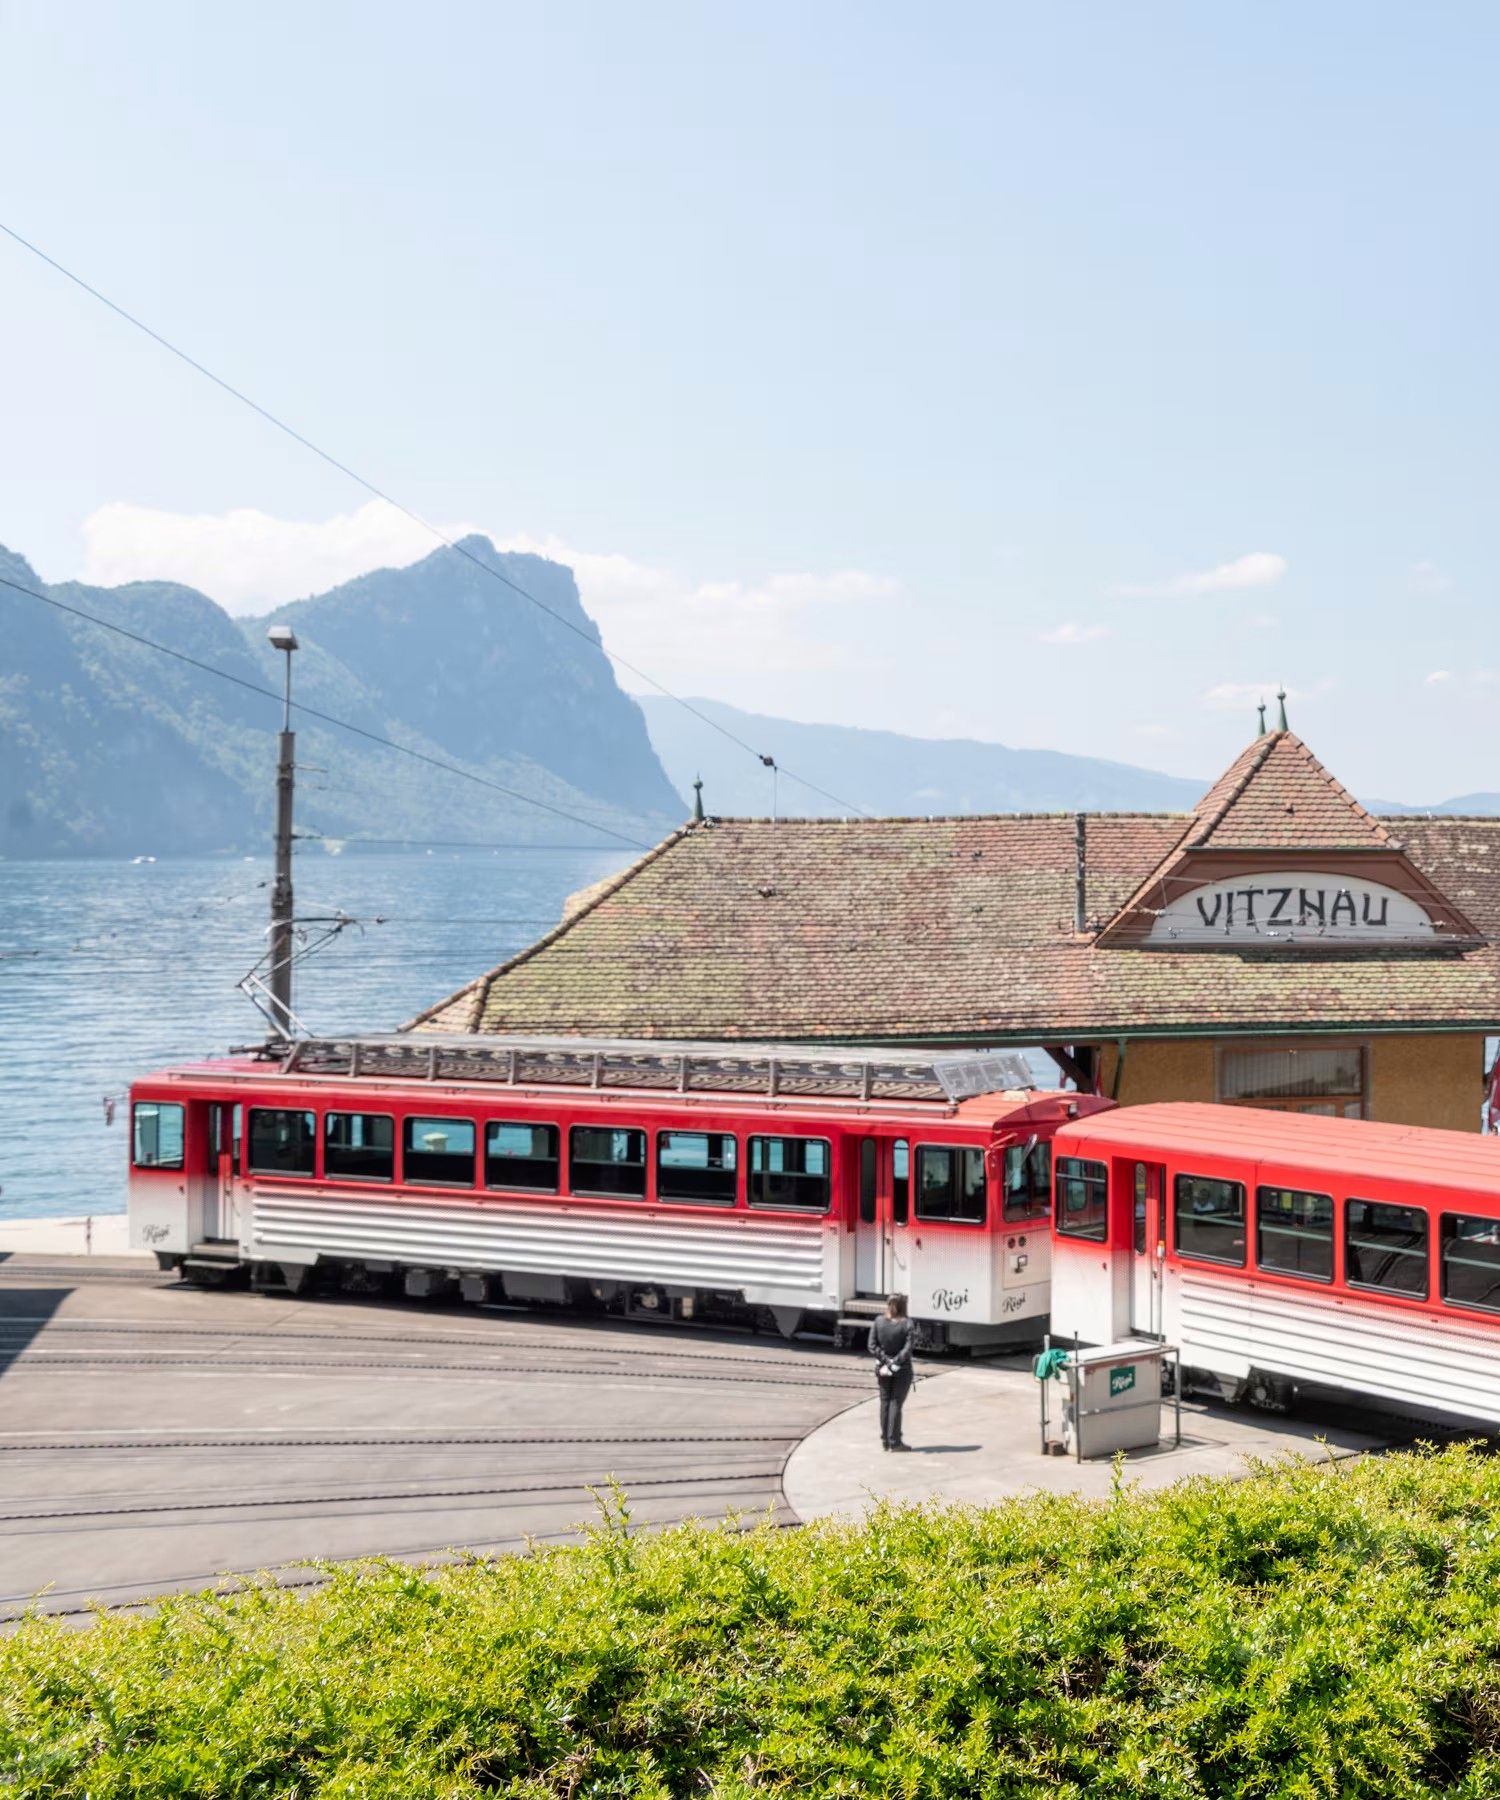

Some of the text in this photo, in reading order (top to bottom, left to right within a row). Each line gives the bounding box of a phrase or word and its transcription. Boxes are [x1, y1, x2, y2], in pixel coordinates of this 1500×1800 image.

[1196, 888, 1389, 926] VITZNAU
[932, 1288, 969, 1311] Rigi
[1002, 1292, 1026, 1313] Rigi
